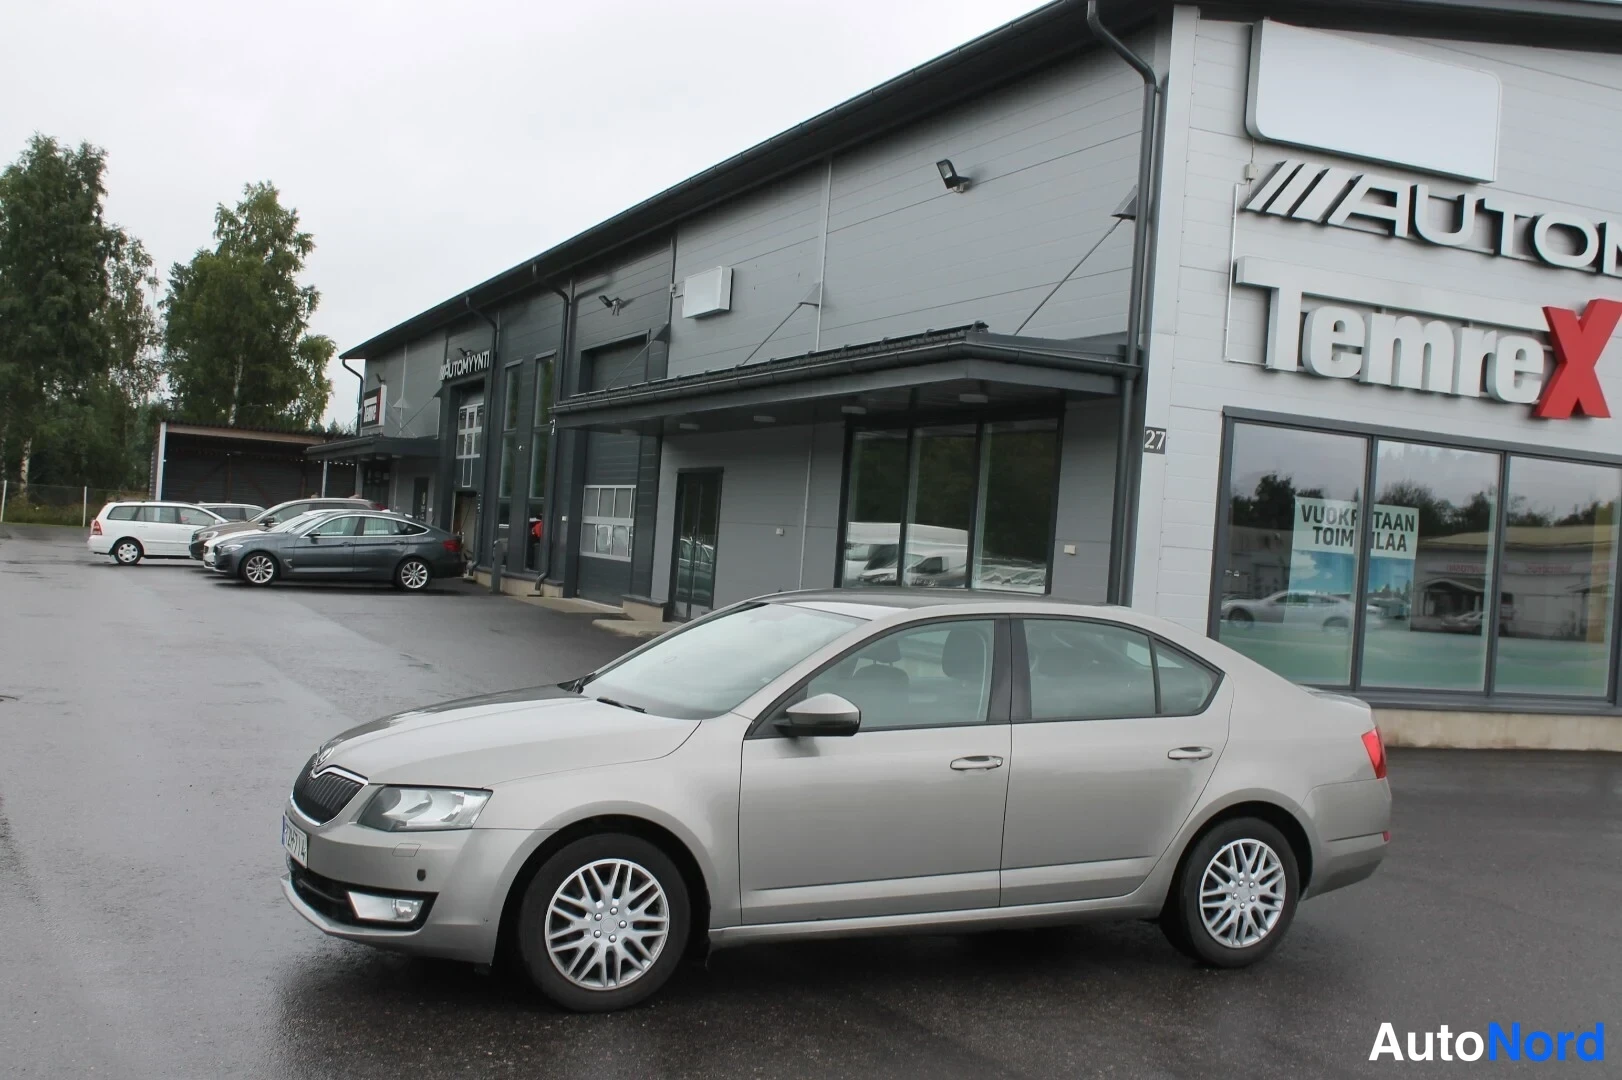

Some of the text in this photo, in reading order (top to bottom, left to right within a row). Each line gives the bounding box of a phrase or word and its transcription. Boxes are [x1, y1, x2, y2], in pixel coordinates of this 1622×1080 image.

[1327, 174, 1622, 277] AUTO
[1145, 429, 1166, 450] 27
[1301, 504, 1415, 533] VUOKRTAAN
[1312, 525, 1408, 552] TOIMILAA
